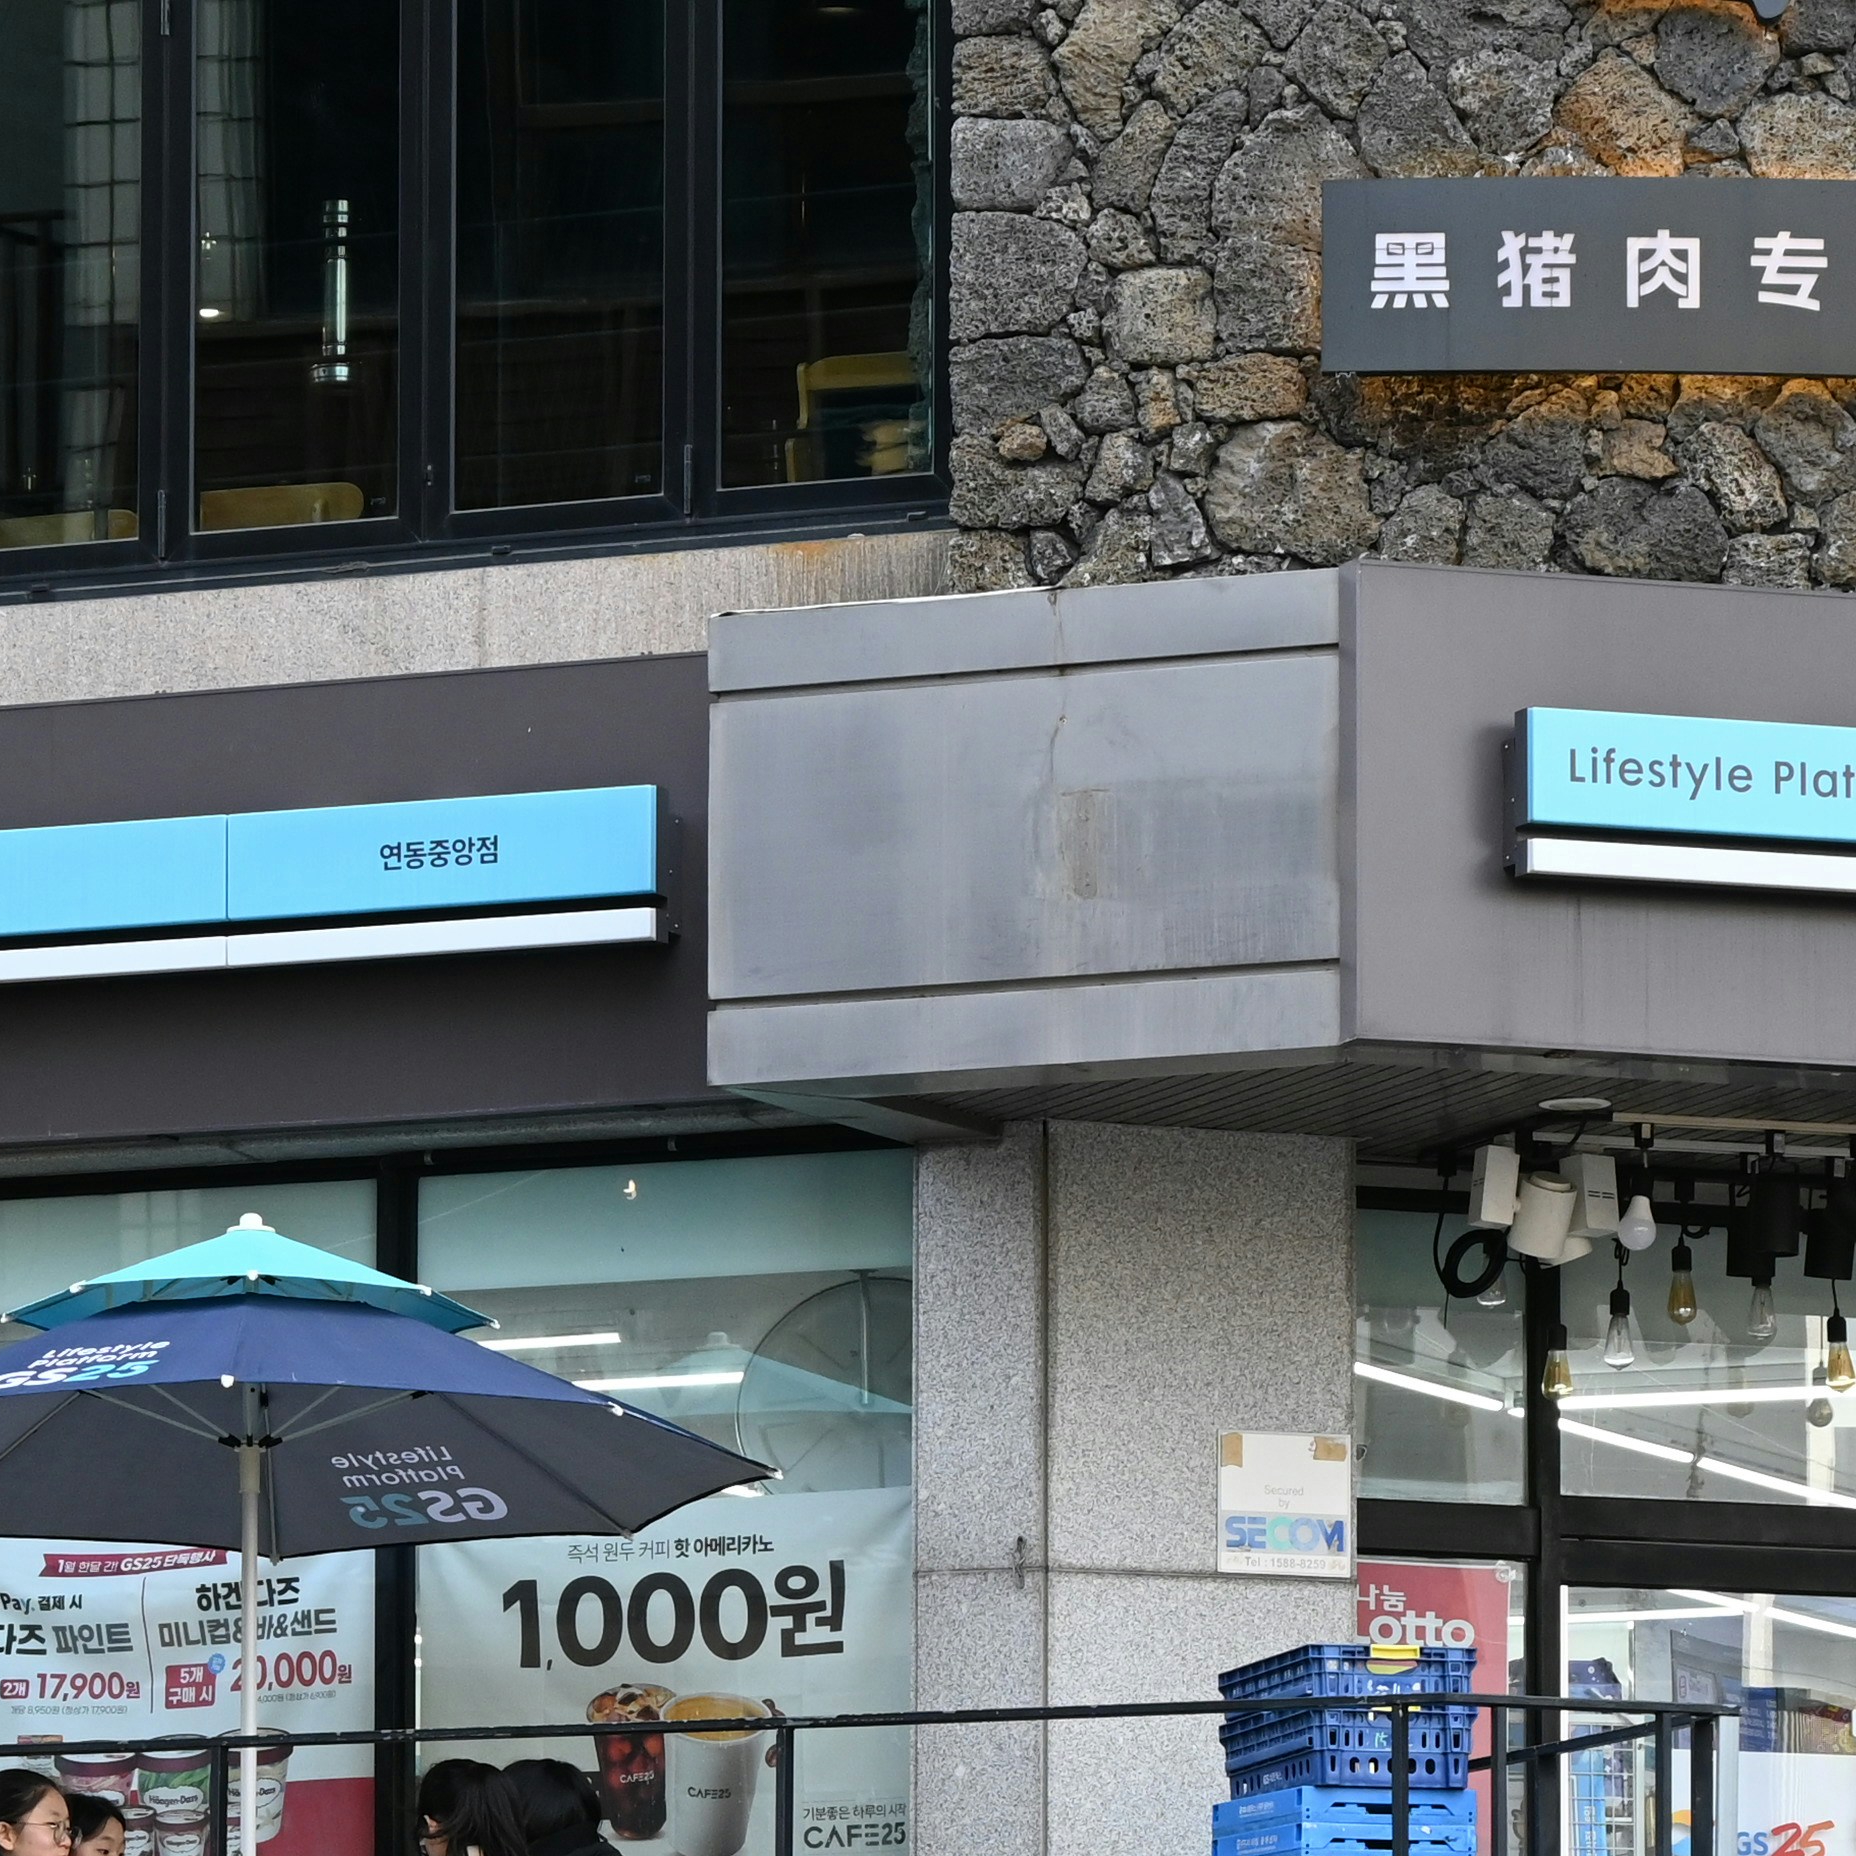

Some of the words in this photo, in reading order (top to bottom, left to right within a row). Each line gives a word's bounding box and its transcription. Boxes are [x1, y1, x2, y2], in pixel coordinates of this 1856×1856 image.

[1569, 747, 1753, 800] Lifestyle
[378, 834, 500, 872] 연동중앙점
[42, 1341, 170, 1358] Lifestyle
[28, 1351, 157, 1369] Platform
[1264, 1484, 1304, 1497] Secured
[1277, 1497, 1290, 1509] by
[1225, 1515, 1345, 1552] SECOM
[568, 1542, 599, 1564] 즉석
[603, 1542, 635, 1562] 원두
[639, 1540, 671, 1560] 커피
[674, 1538, 690, 1558] 핫
[693, 1534, 775, 1557] 아메리카노
[120, 1555, 162, 1572] GS25
[1245, 1557, 1262, 1568] Tel
[1270, 1557, 1327, 1569] 1588-8259
[37, 1596, 65, 1611] 결제
[68, 1594, 83, 1610] 시
[502, 1559, 845, 1671] 1,000원
[52, 1622, 134, 1655] 파인트
[180, 1667, 204, 1684] 5개
[2, 1682, 27, 1697] 2개
[36, 1671, 141, 1702] 17,900원
[168, 1688, 196, 1705] 구매
[199, 1686, 213, 1703] 시
[619, 1771, 655, 1784] CAFE25
[687, 1786, 732, 1800] CAFE25
[803, 1806, 850, 1820] 기분좋은
[853, 1804, 886, 1818] 하루의
[803, 1822, 907, 1849] CAFE25
